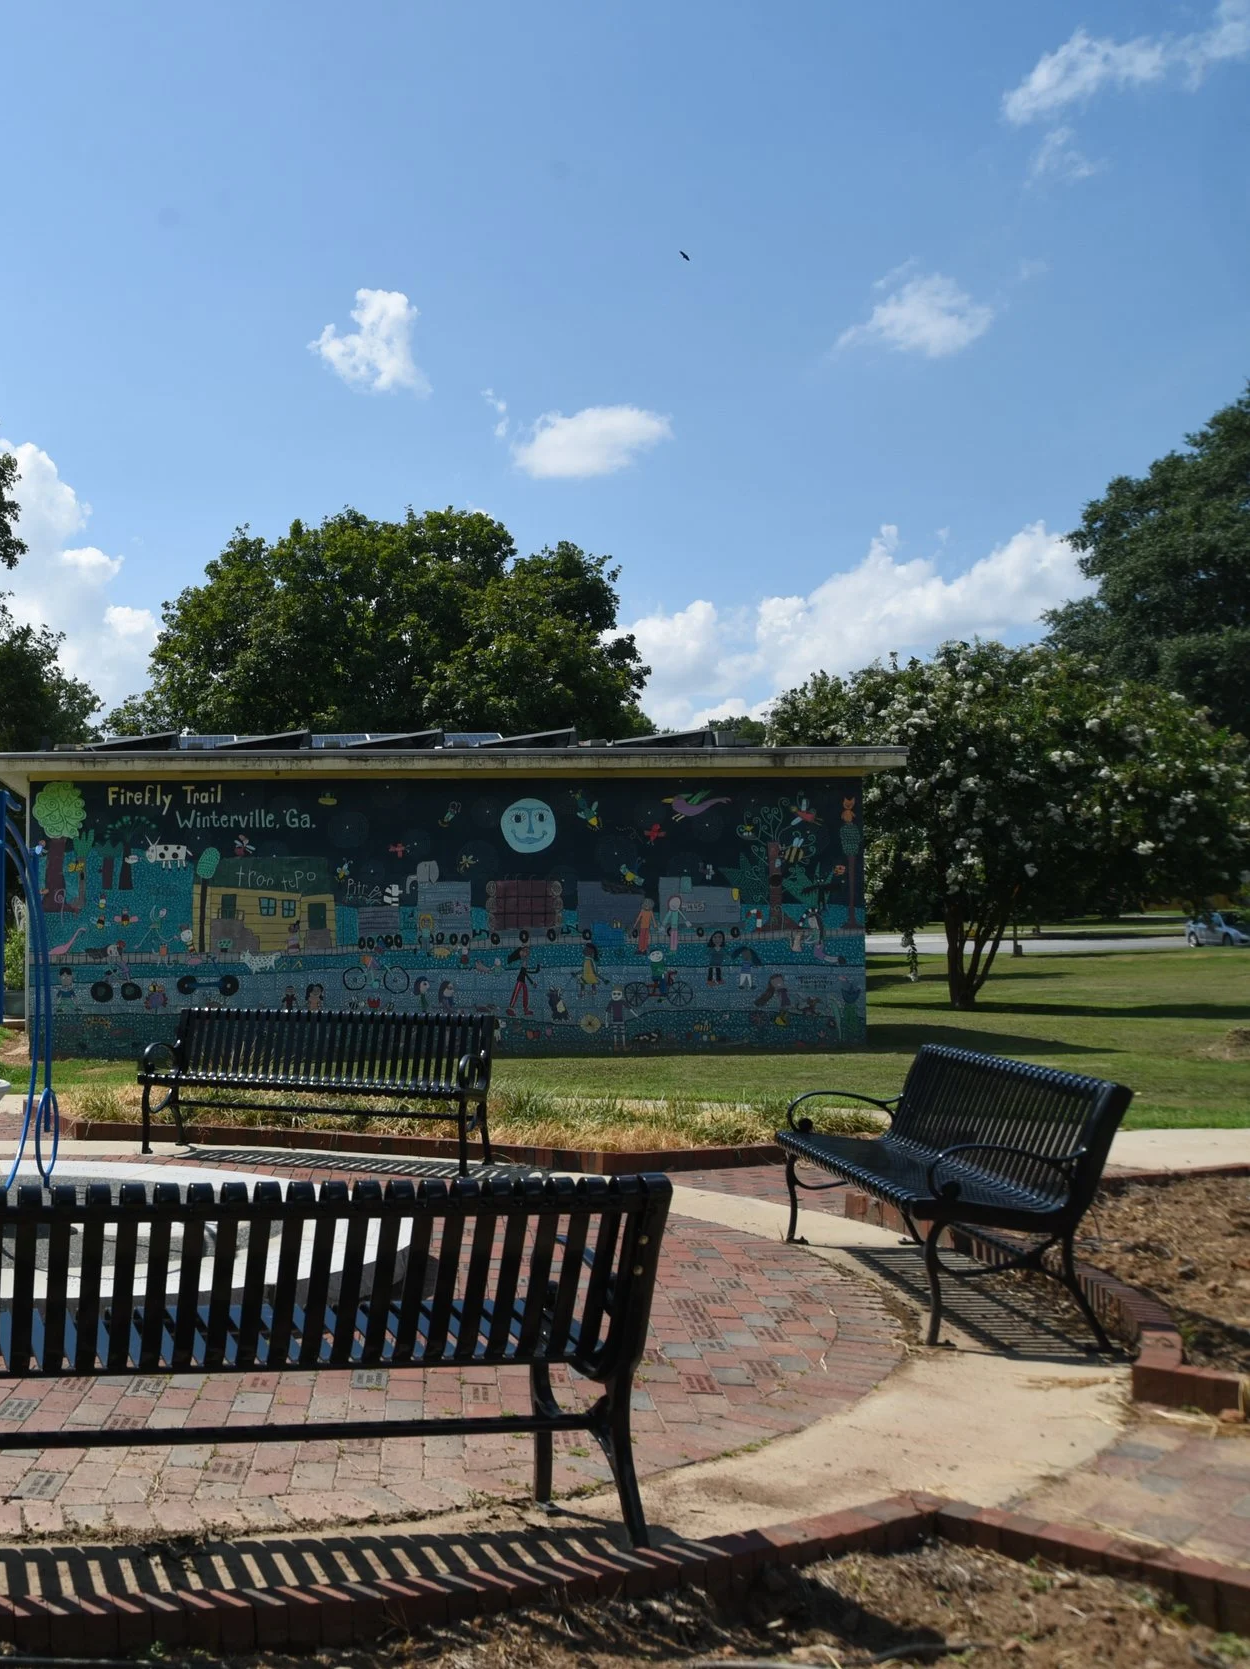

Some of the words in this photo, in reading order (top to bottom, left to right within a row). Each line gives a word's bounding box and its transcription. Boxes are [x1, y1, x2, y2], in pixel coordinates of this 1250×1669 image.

[108, 784, 172, 815] Firefly
[182, 784, 221, 804] Trail
[176, 808, 280, 829] Winterville,
[285, 808, 316, 829] Ga.
